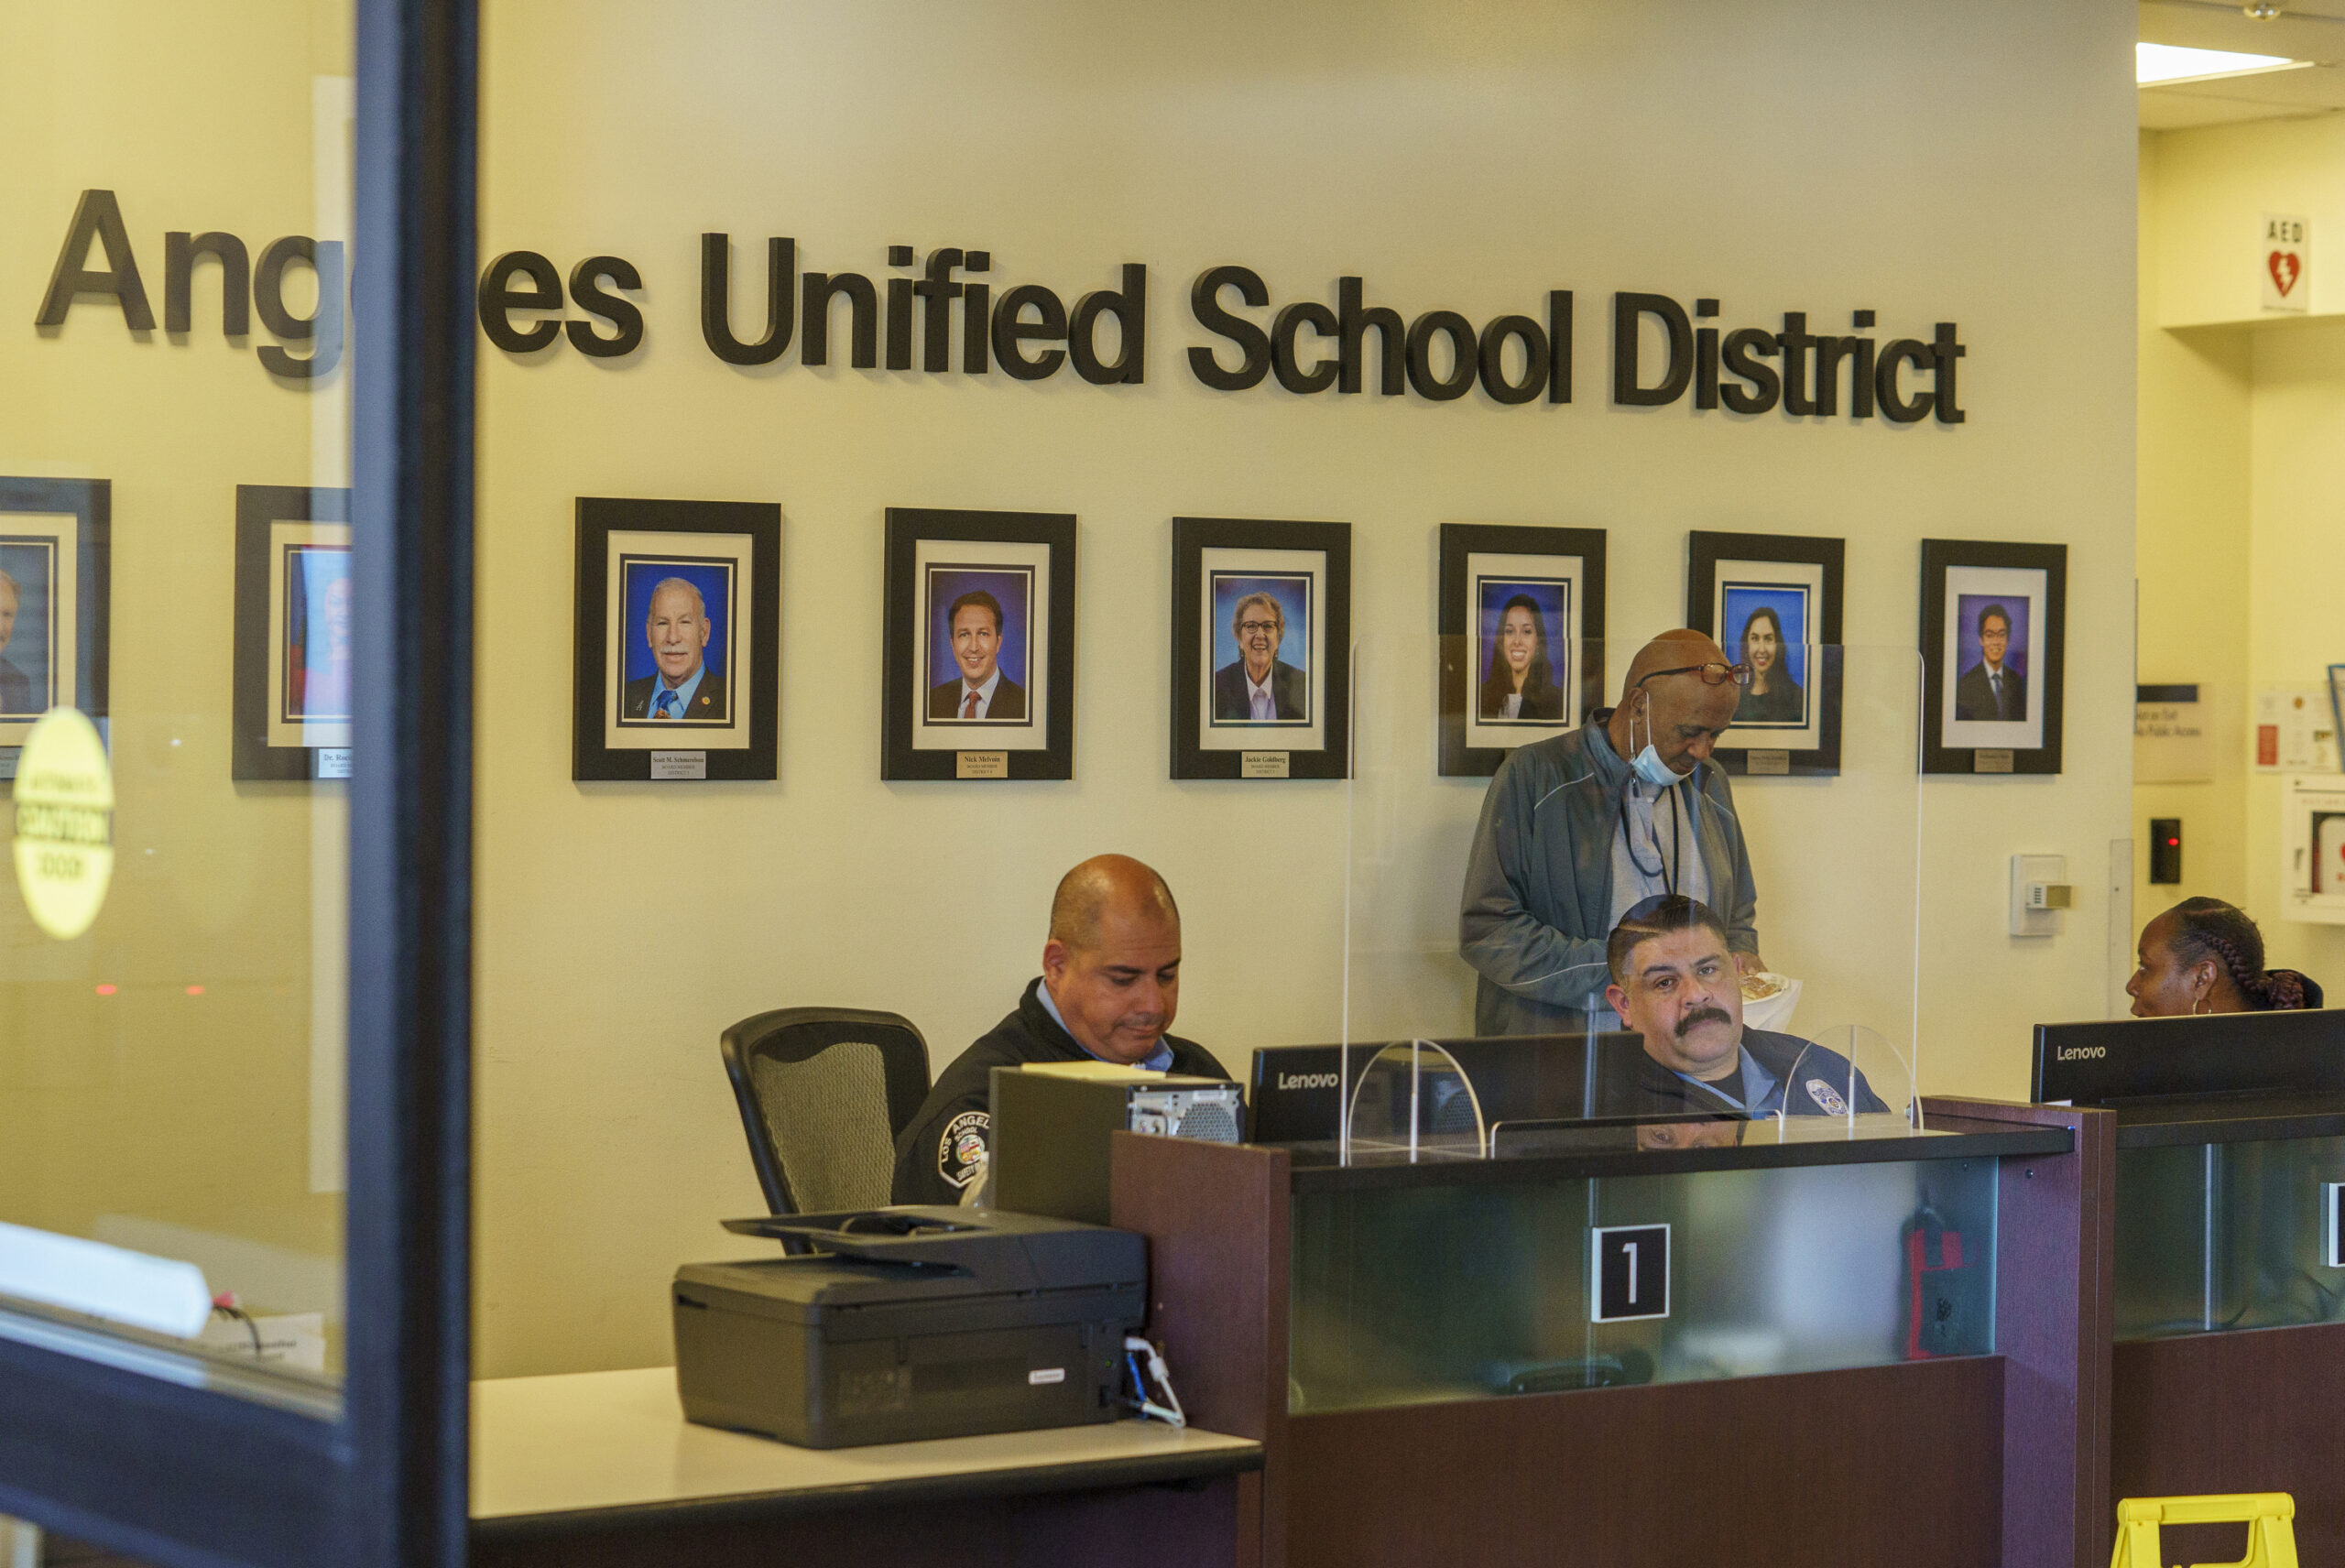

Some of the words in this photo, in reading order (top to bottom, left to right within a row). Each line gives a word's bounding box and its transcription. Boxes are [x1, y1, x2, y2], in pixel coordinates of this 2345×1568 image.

[2266, 220, 2304, 244] AED
[34, 187, 645, 379] Anges
[700, 232, 1147, 387] Unified
[1186, 265, 1574, 404] School
[1614, 290, 1968, 424] District
[1262, 756, 1286, 764] Goldberg
[2057, 1046, 2106, 1061] Lenovo
[1278, 1072, 1338, 1090] Lenovo
[954, 1127, 978, 1142] SCHOOL
[942, 1137, 953, 1163] LOS
[1622, 1242, 1637, 1304] 1
